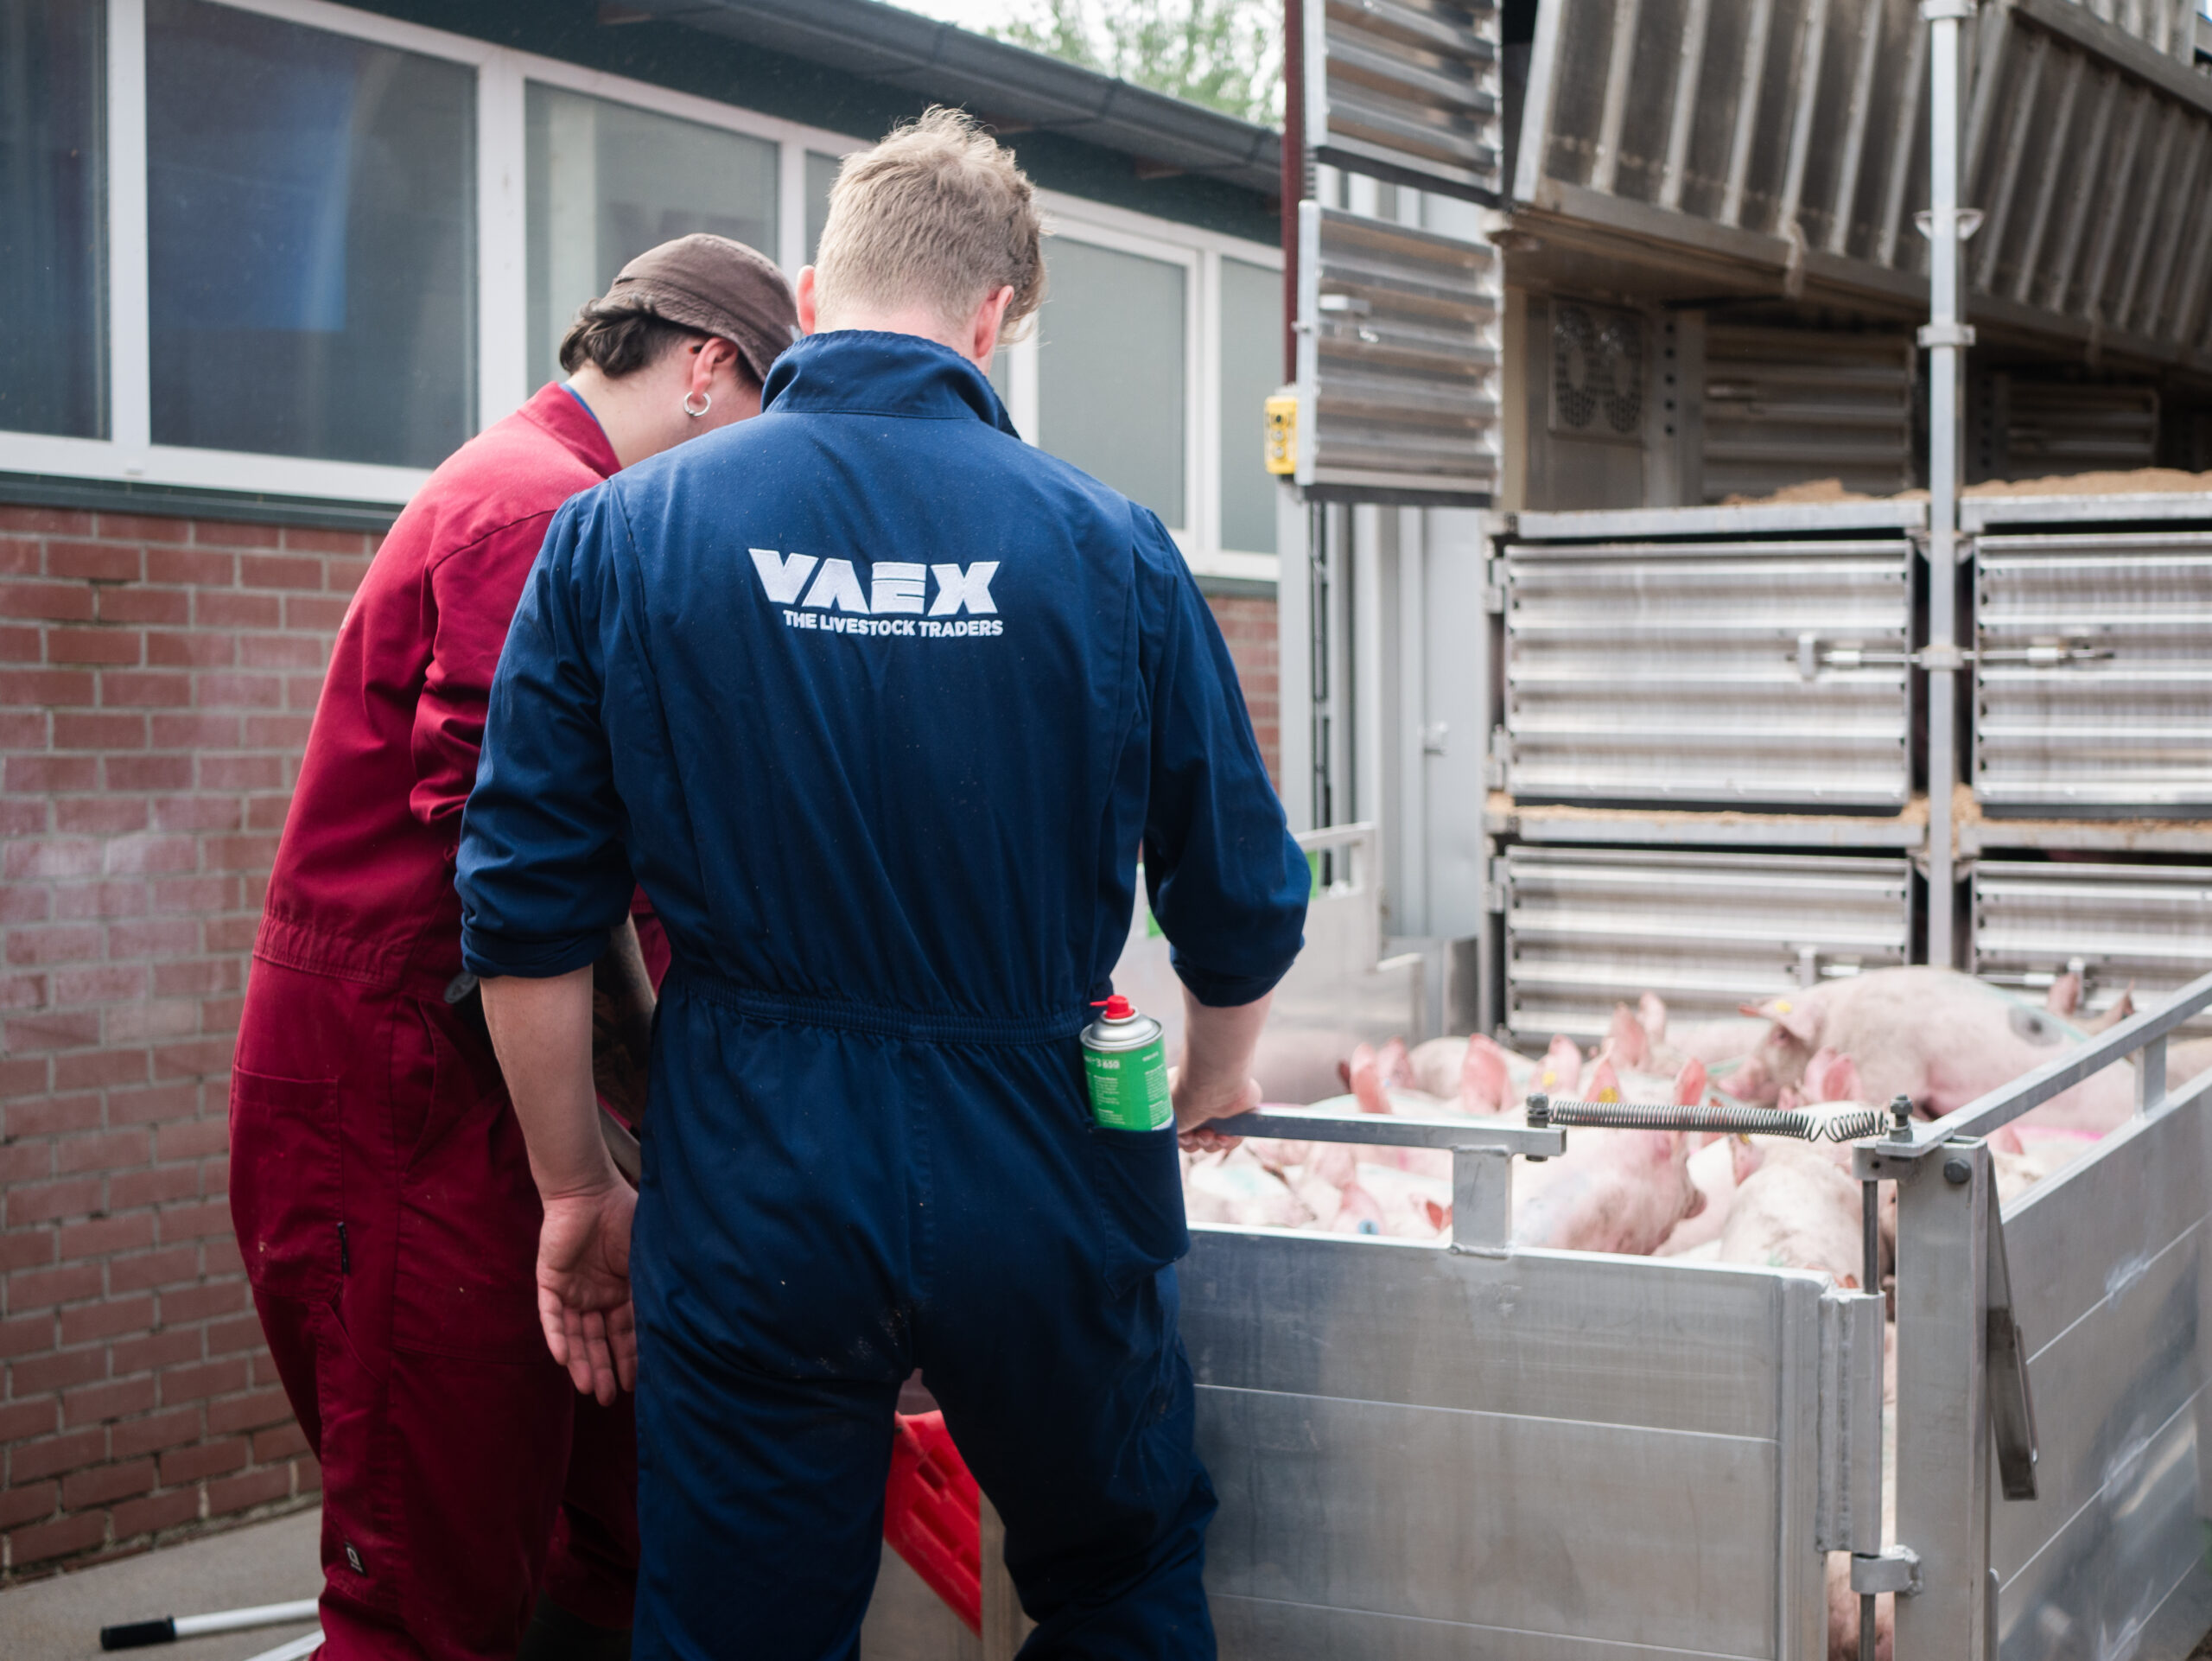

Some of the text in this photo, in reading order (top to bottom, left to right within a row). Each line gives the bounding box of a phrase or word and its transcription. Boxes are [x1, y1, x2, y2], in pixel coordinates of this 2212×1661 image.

[748, 548, 1000, 616] VAEX
[783, 609, 1003, 638] THE LIVESTOCK TRADERS
